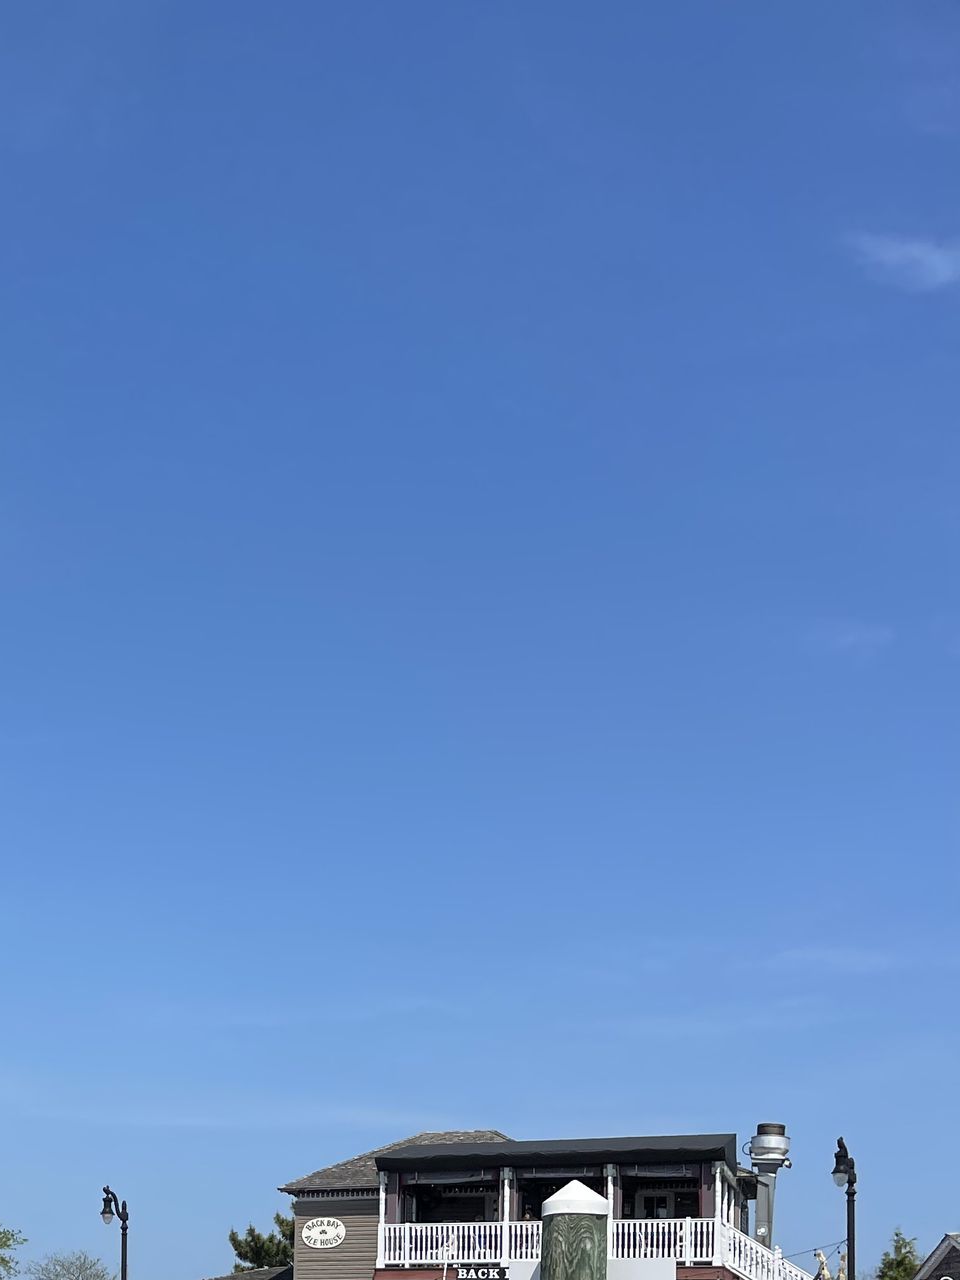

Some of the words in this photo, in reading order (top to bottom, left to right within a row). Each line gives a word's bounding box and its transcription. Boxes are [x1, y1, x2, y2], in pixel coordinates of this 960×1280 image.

[305, 1219, 325, 1231] BACK
[326, 1219, 341, 1229] BAY
[305, 1235, 319, 1246] ALE
[319, 1233, 344, 1246] HOUSE
[457, 1268, 500, 1279] BACK
